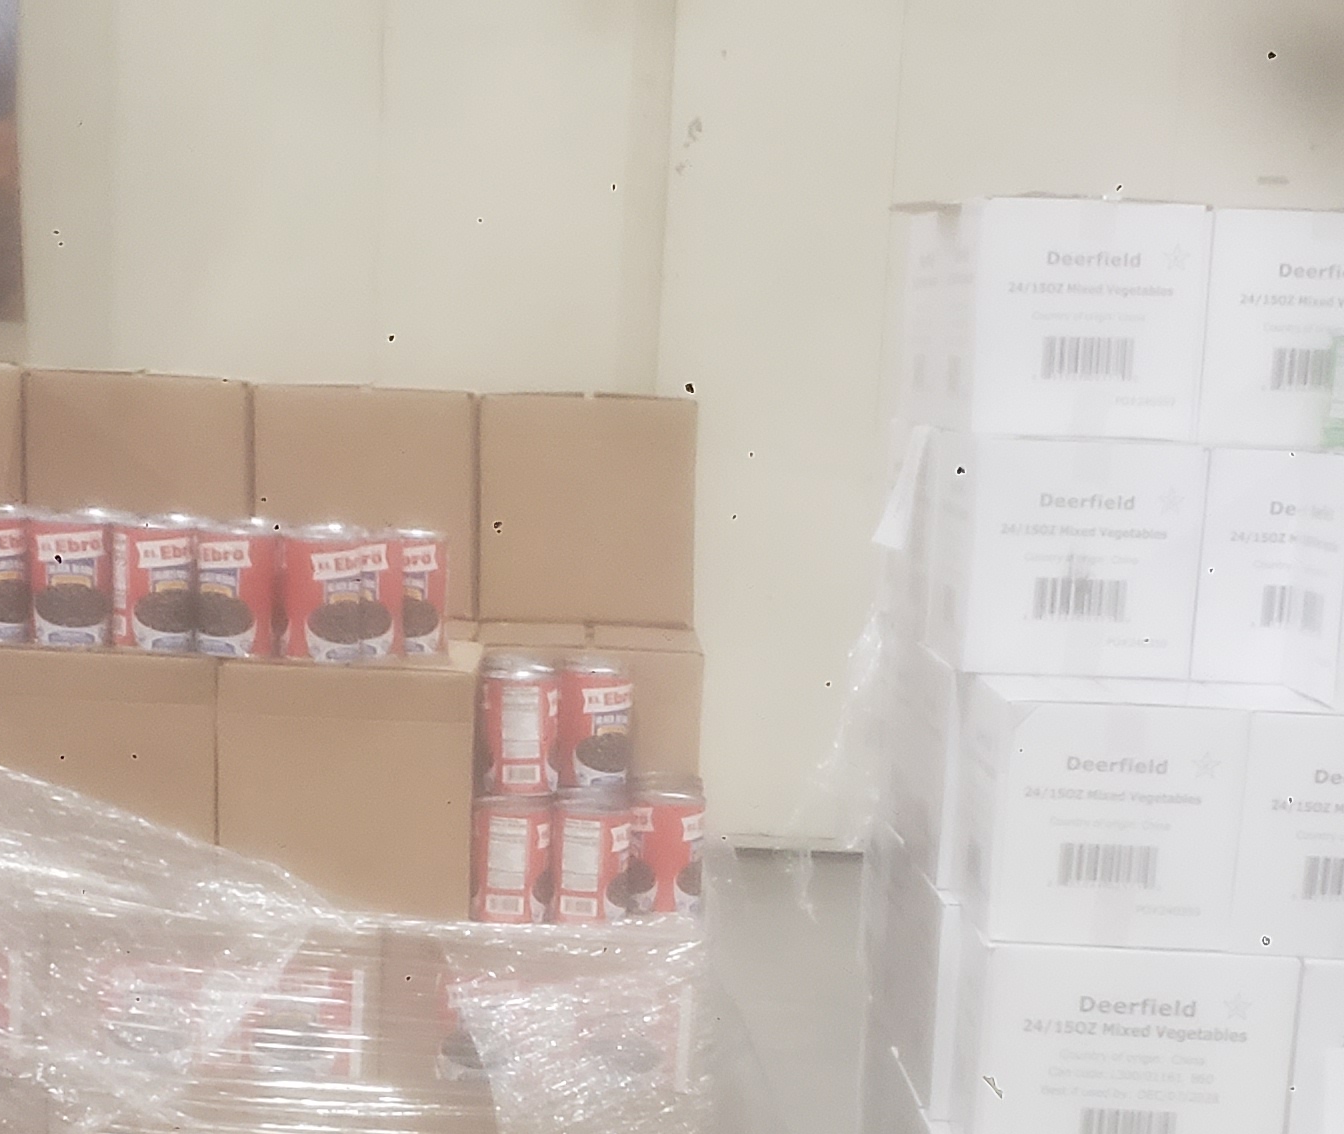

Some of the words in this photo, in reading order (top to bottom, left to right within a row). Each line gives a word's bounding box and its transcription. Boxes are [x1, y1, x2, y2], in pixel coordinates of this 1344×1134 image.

[1047, 251, 1141, 267] Deerfield
[1067, 283, 1103, 294] Mixed
[1106, 285, 1173, 298] Vegetables
[1299, 296, 1334, 307] Mixed
[1039, 493, 1136, 510] Deerfield
[1060, 525, 1096, 536] Mixed
[1100, 527, 1167, 539] Vegetables
[56, 539, 101, 552] Ebro
[1067, 756, 1168, 774] Deerfield
[1087, 790, 1125, 801] Mixed
[1129, 792, 1202, 805] Vegetables
[1079, 996, 1197, 1018] Deerfield
[1023, 1019, 1097, 1035] 24/15OZ
[1102, 1023, 1151, 1037] Mixed
[1157, 1026, 1248, 1042] Vegetables
